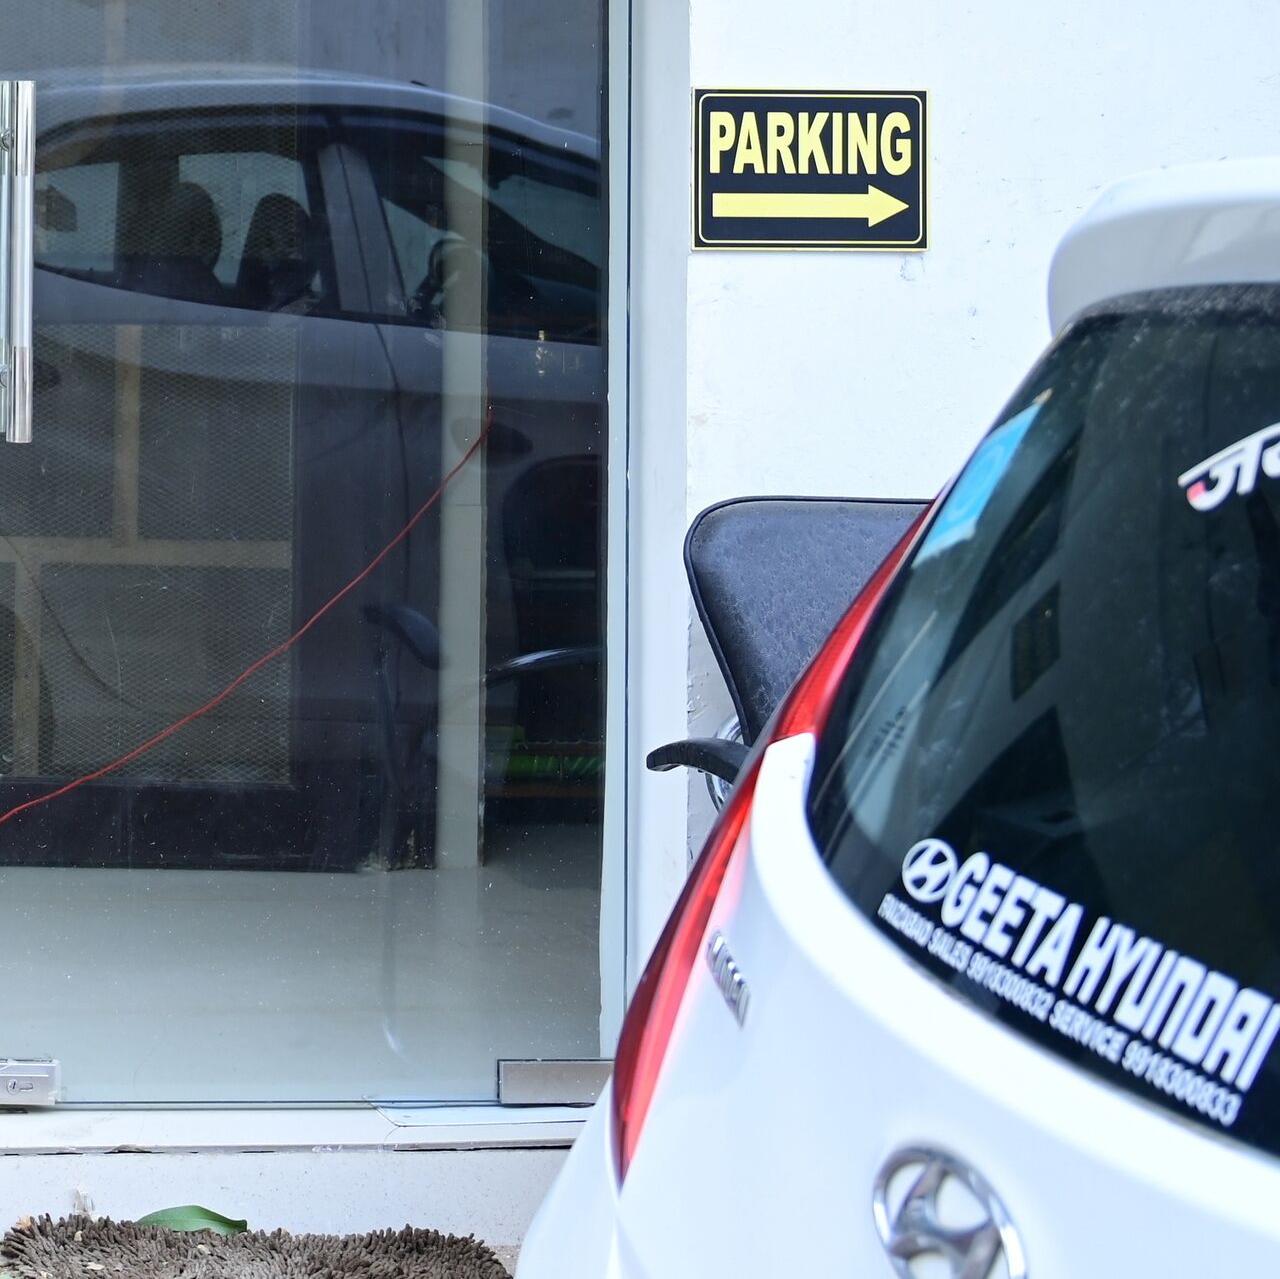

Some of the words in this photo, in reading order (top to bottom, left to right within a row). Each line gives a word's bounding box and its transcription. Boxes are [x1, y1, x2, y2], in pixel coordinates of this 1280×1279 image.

[710, 111, 912, 176] PARKING
[927, 927, 974, 973] SALES
[1049, 999, 1129, 1064] SERVICE
[941, 852, 1084, 988] GEETA
[1062, 917, 1280, 1092] HYUNDAI
